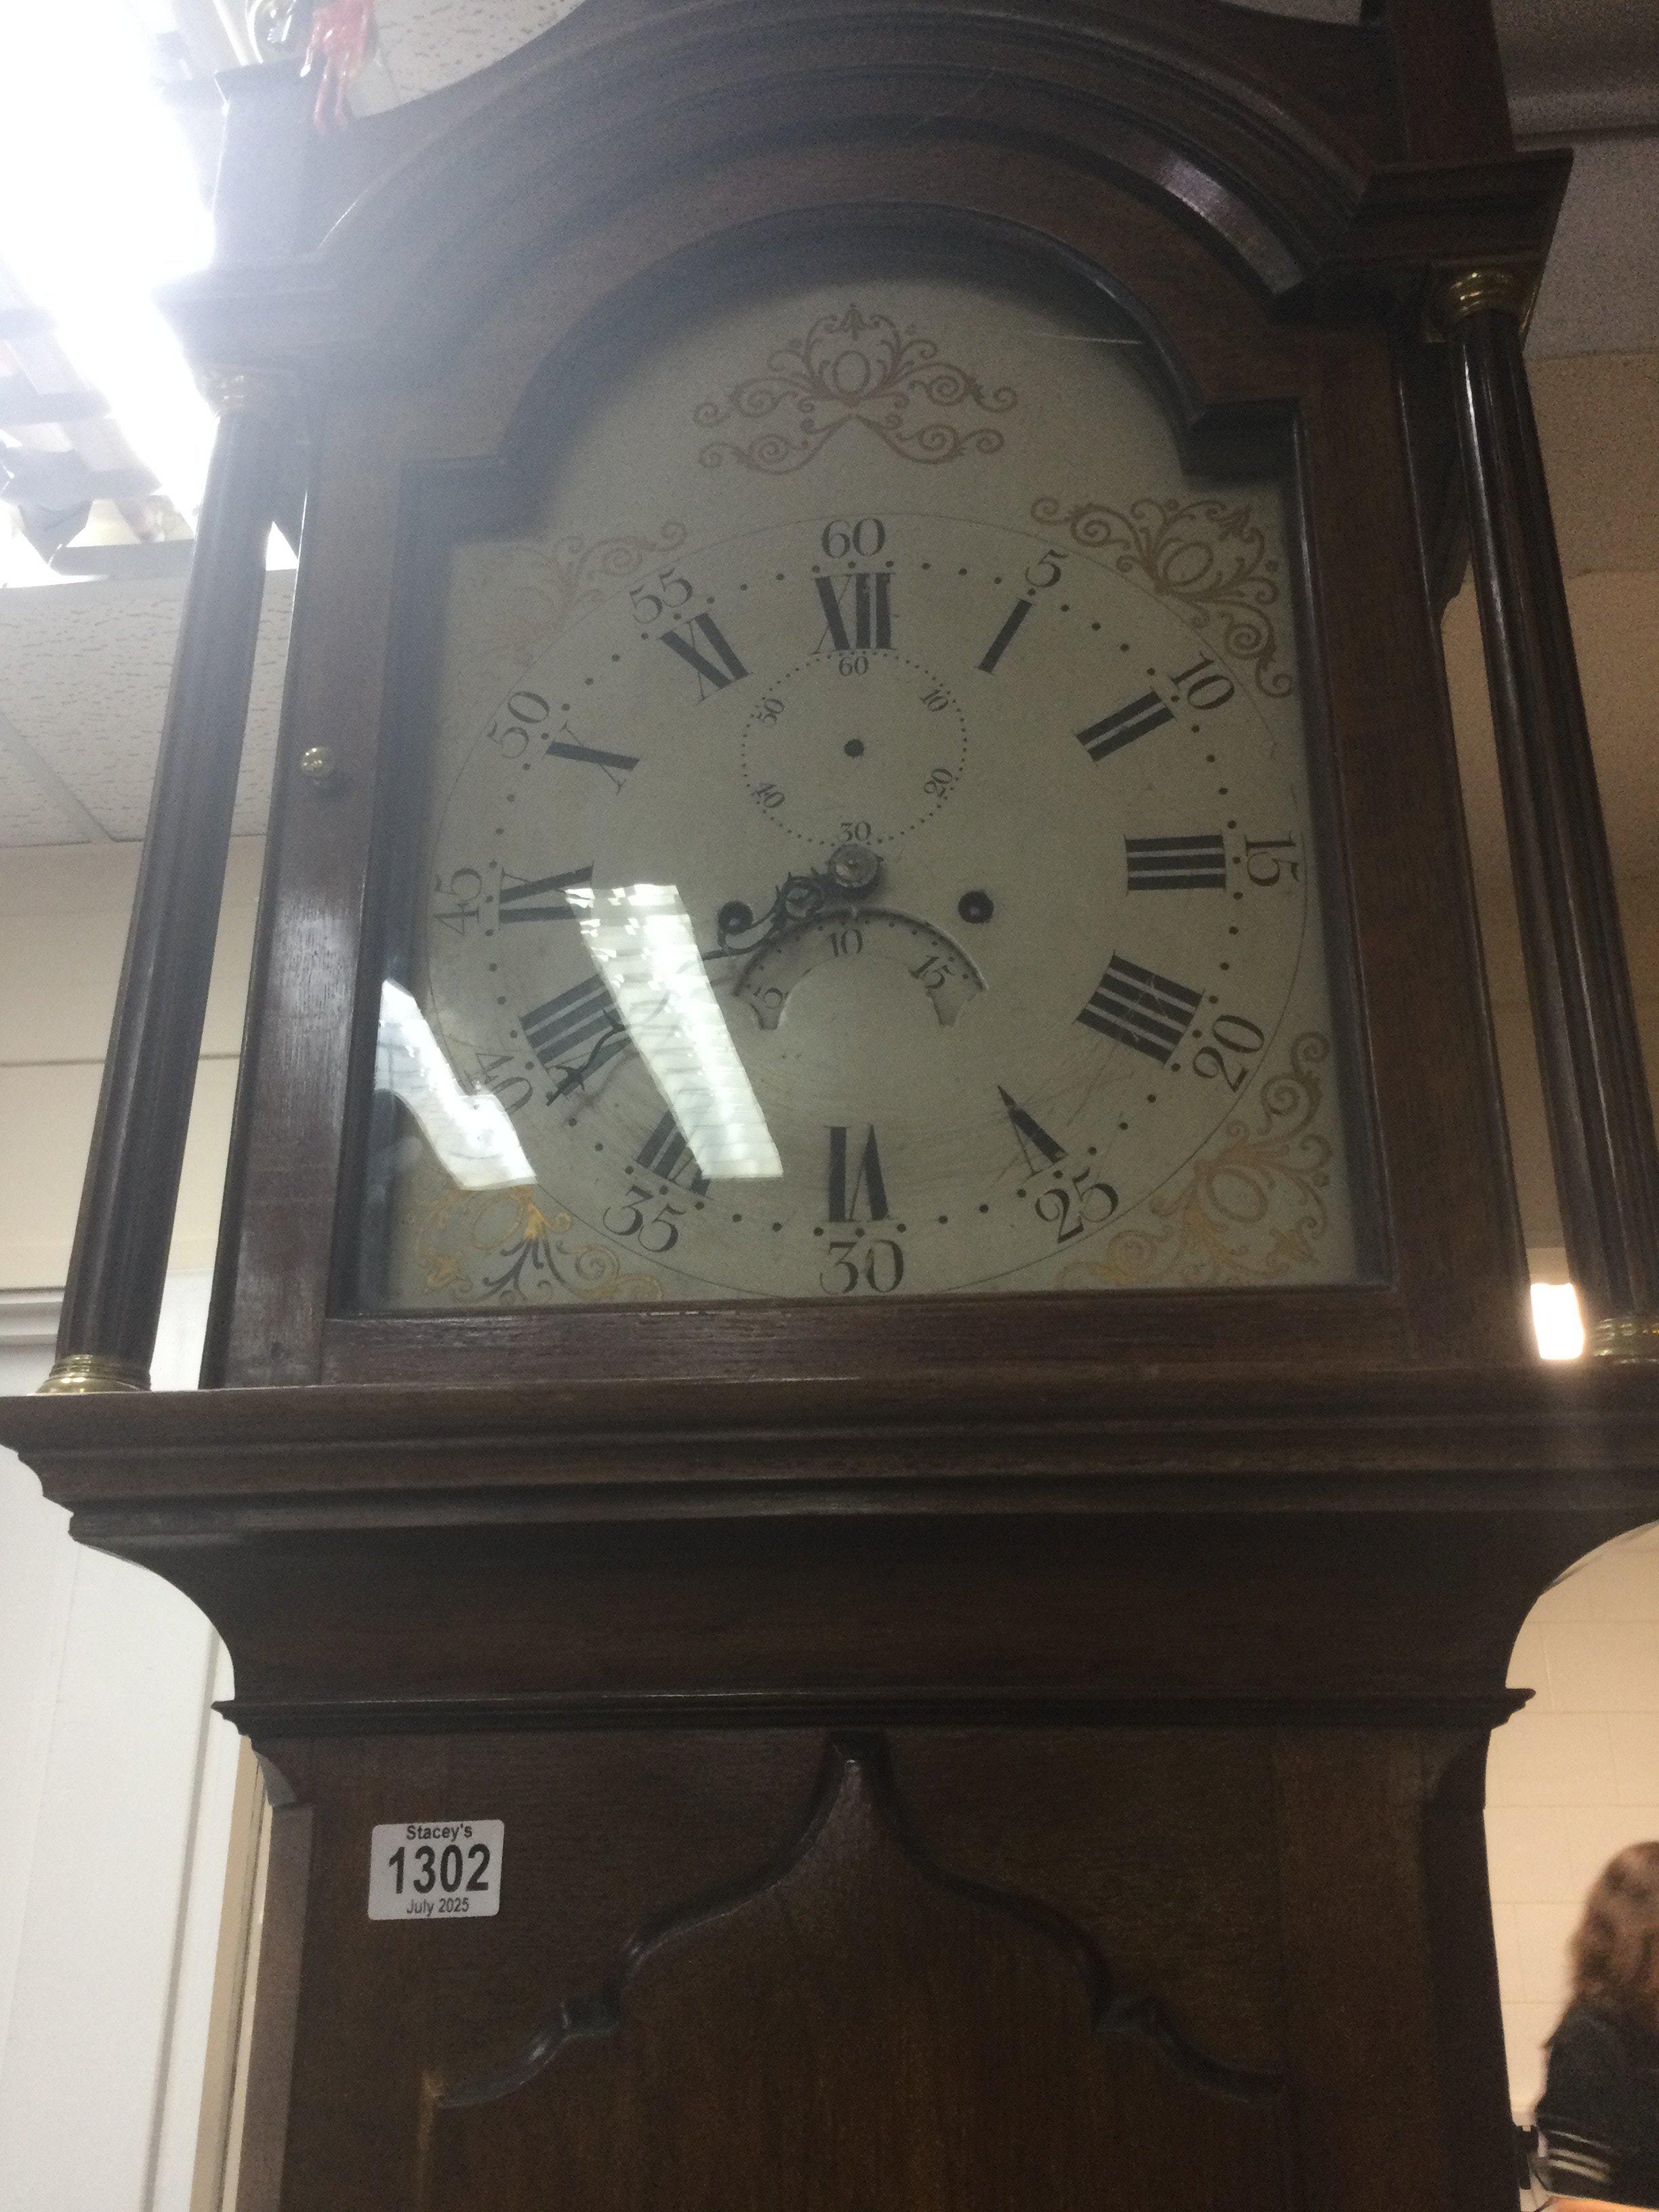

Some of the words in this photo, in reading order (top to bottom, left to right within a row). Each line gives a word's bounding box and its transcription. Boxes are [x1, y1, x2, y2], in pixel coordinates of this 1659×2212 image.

[821, 518, 886, 559] 60
[629, 568, 693, 624] 55
[1025, 548, 1069, 590] 5
[810, 572, 896, 655] XII
[656, 612, 754, 705] XI
[838, 655, 869, 676] 60
[1169, 652, 1235, 712] 10
[485, 690, 550, 759] 50
[756, 697, 785, 729] 50
[920, 689, 949, 712] 10
[1072, 690, 1178, 763] II
[543, 721, 641, 795] X
[923, 768, 953, 798] 20
[751, 782, 786, 809] 40
[840, 821, 872, 842] 30
[1244, 830, 1301, 888] 15
[1124, 834, 1227, 897] III
[432, 867, 483, 936] 45
[826, 928, 863, 958] 10
[752, 985, 790, 1010] 5
[908, 954, 956, 990] 15
[1192, 1015, 1266, 1093] 20
[997, 1084, 1069, 1179] V
[824, 1124, 891, 1223] VI
[602, 1183, 687, 1252] 35
[1033, 1168, 1120, 1244] 25
[819, 1238, 904, 1295] 30
[406, 1824, 472, 1843] Stacey's
[388, 1843, 491, 1894] 1302
[406, 1899, 434, 1917] July
[438, 1898, 470, 1913] 2025
